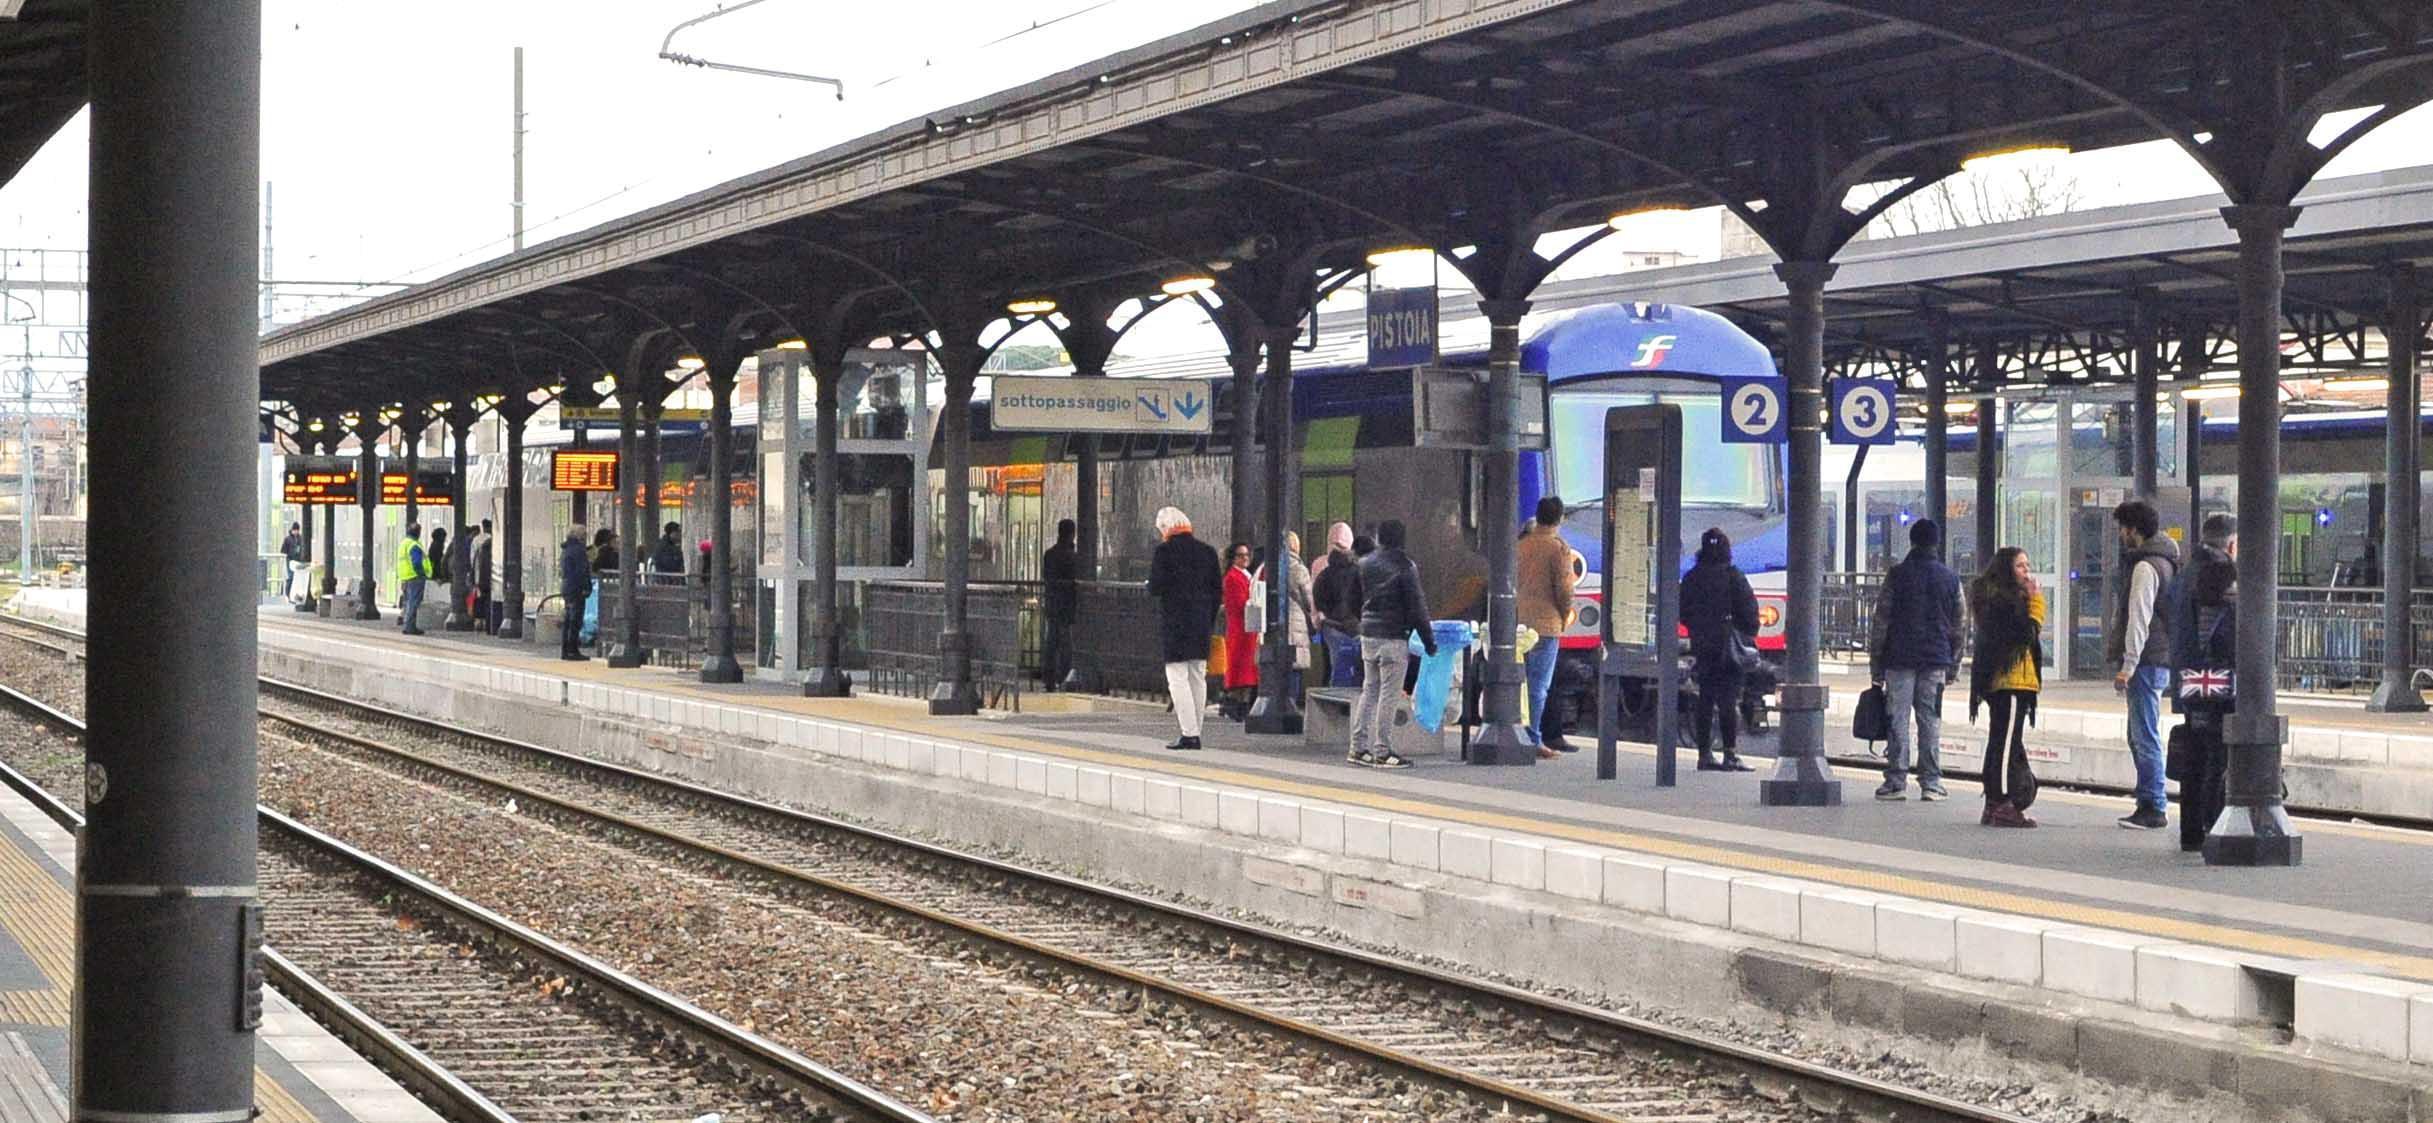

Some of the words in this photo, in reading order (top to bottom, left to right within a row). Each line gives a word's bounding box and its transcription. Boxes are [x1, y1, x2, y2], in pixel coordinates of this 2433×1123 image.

[1370, 308, 1431, 349] PISTOIA
[1000, 393, 1131, 411] sottopassaggio
[1743, 393, 1767, 426] 2
[1852, 395, 1877, 428] 3
